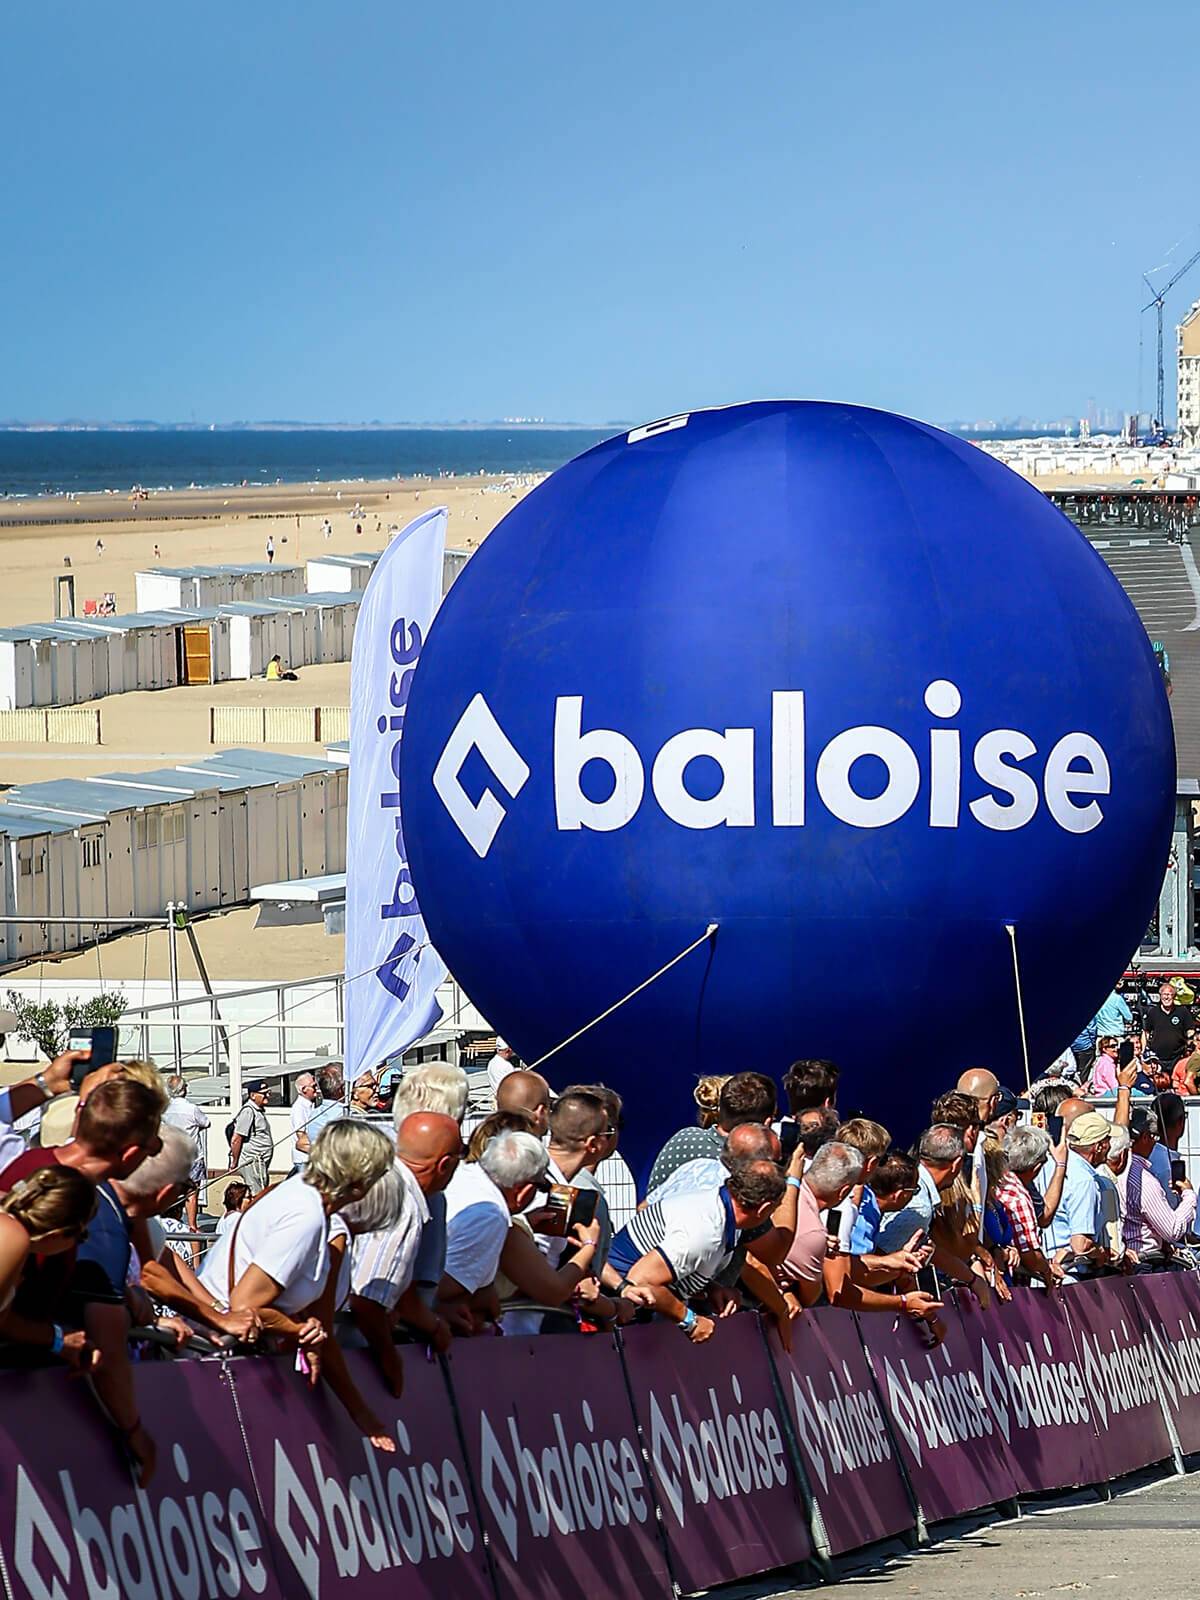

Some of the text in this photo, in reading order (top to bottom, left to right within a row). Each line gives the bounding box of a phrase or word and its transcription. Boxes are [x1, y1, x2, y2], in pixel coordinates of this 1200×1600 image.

[377, 616, 423, 920] bise
[553, 679, 1112, 834] baloise
[805, 1359, 891, 1474] baloise
[900, 1342, 993, 1449] baloise
[998, 1333, 1090, 1429] baloise
[1093, 1320, 1156, 1414] baloise
[307, 1419, 475, 1578] baloise
[508, 1400, 650, 1538] baloise
[671, 1374, 788, 1504] baloise
[58, 1442, 268, 1600] baloise
